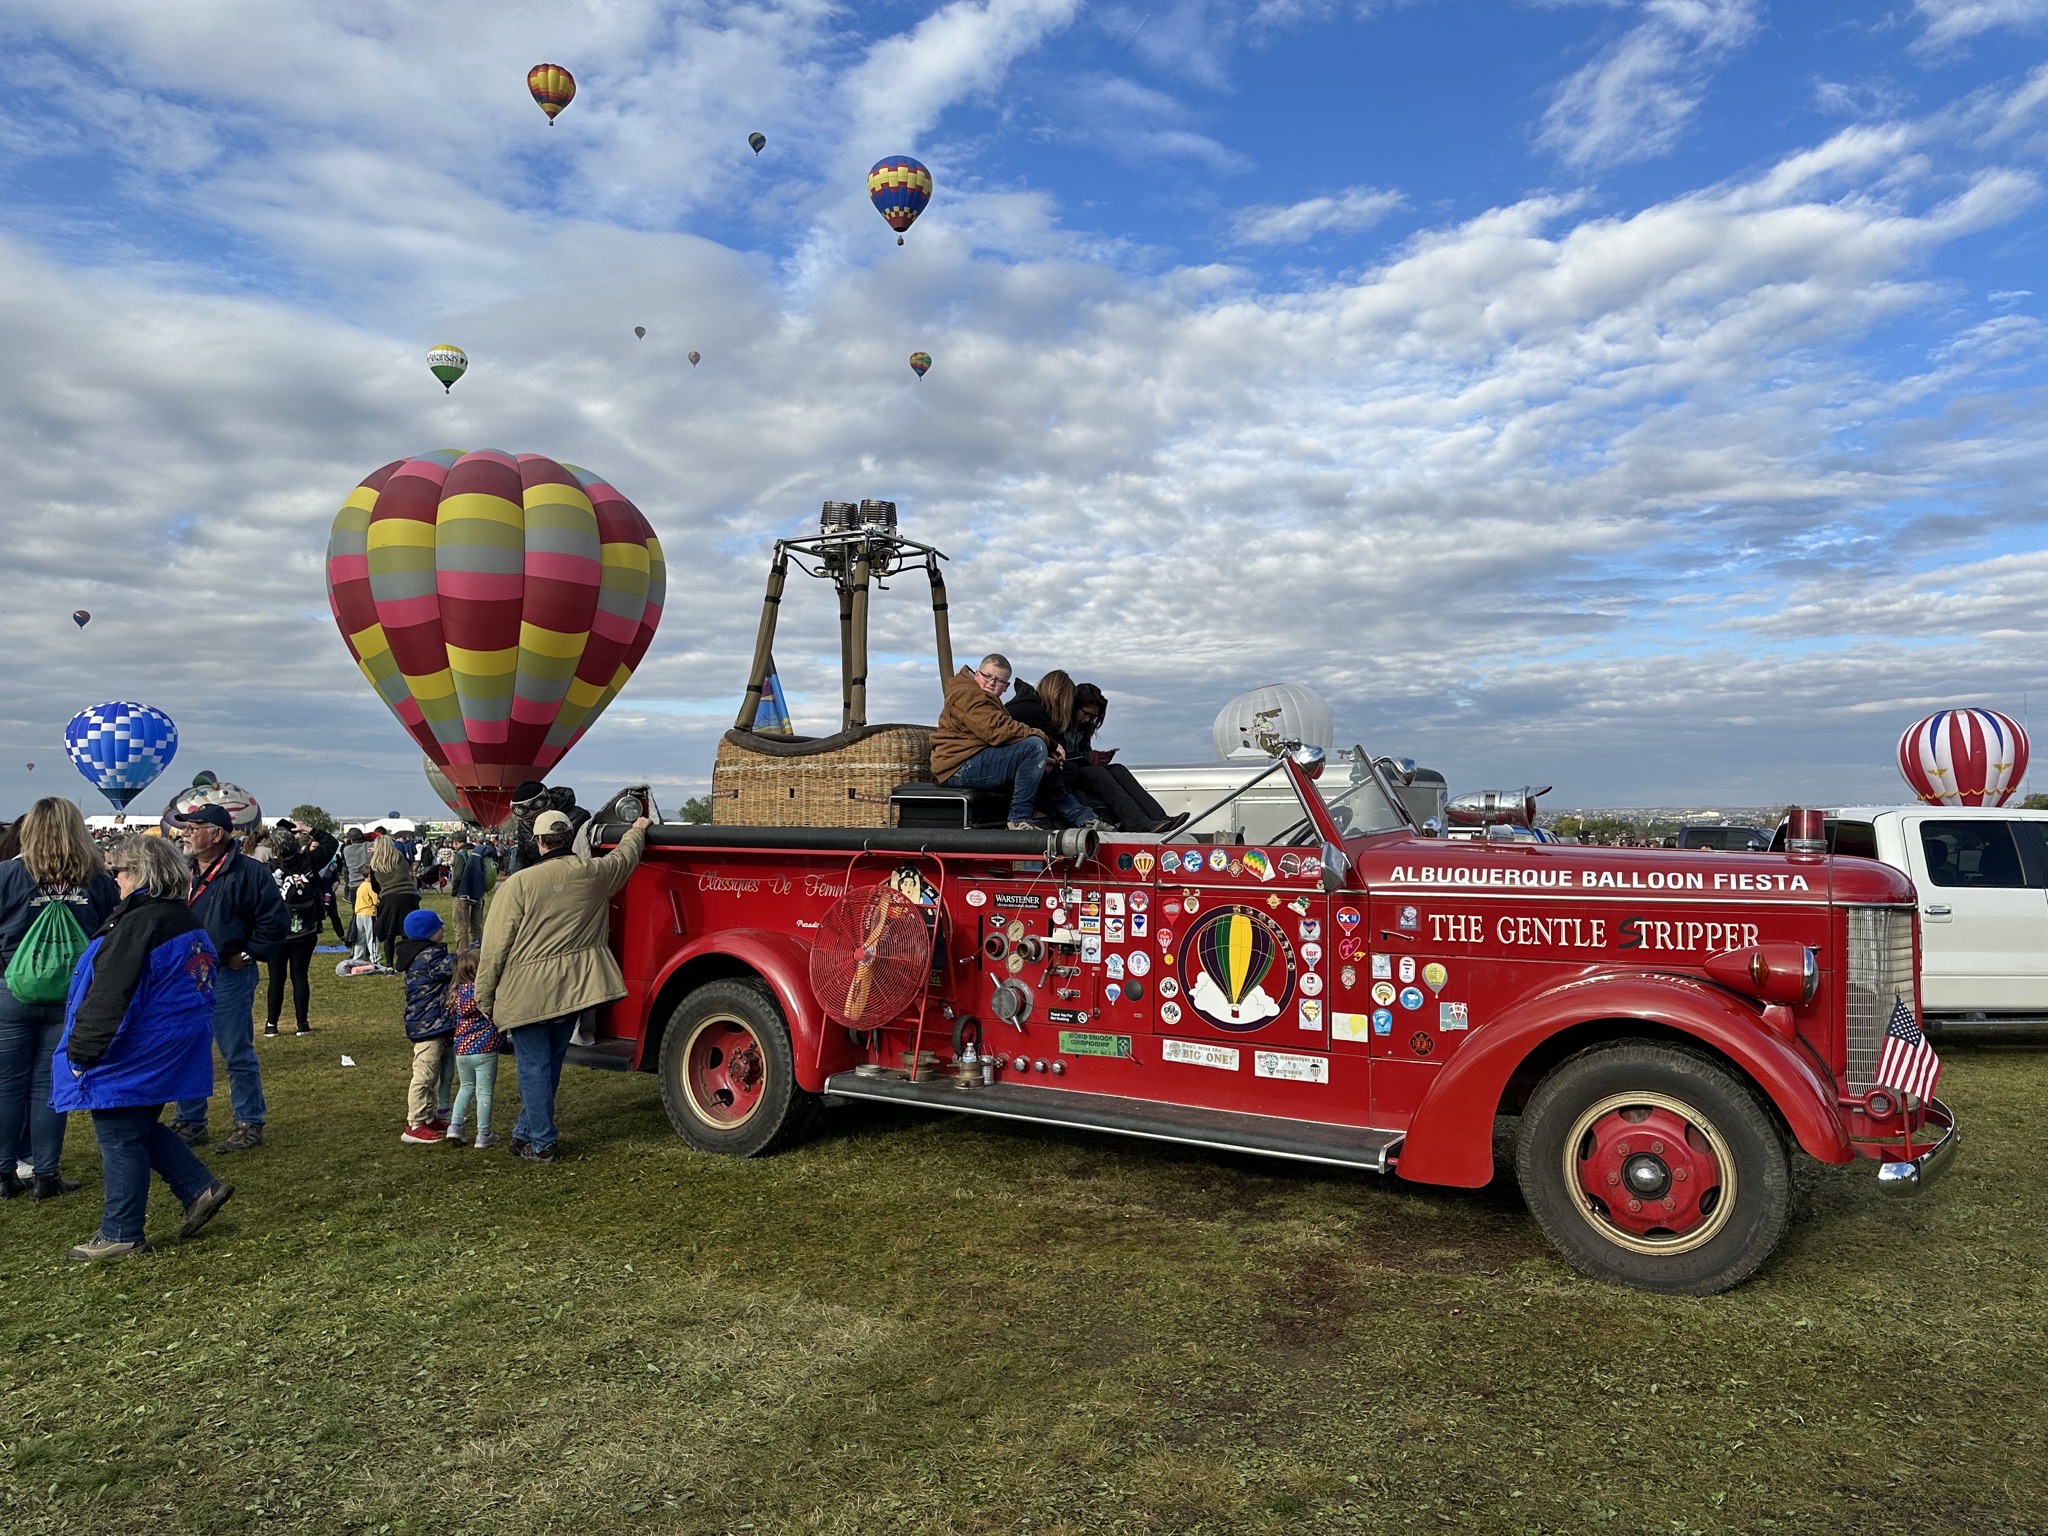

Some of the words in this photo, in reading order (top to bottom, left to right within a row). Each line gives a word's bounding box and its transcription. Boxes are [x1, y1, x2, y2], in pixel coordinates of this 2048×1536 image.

[698, 870, 760, 898] Classiques
[768, 873, 792, 895] De
[1390, 866, 1572, 887] ALBUQUERQUE
[1582, 871, 1703, 890] BALLOON
[1714, 873, 1809, 891] FIESTA
[995, 894, 1040, 904] WARSTEINER
[1428, 914, 1485, 943] THE
[1496, 916, 1608, 948] GENTLE
[1618, 916, 1761, 951] STRIPPER
[1183, 1049, 1201, 1060] BIG
[1206, 1053, 1233, 1065] ONE!
